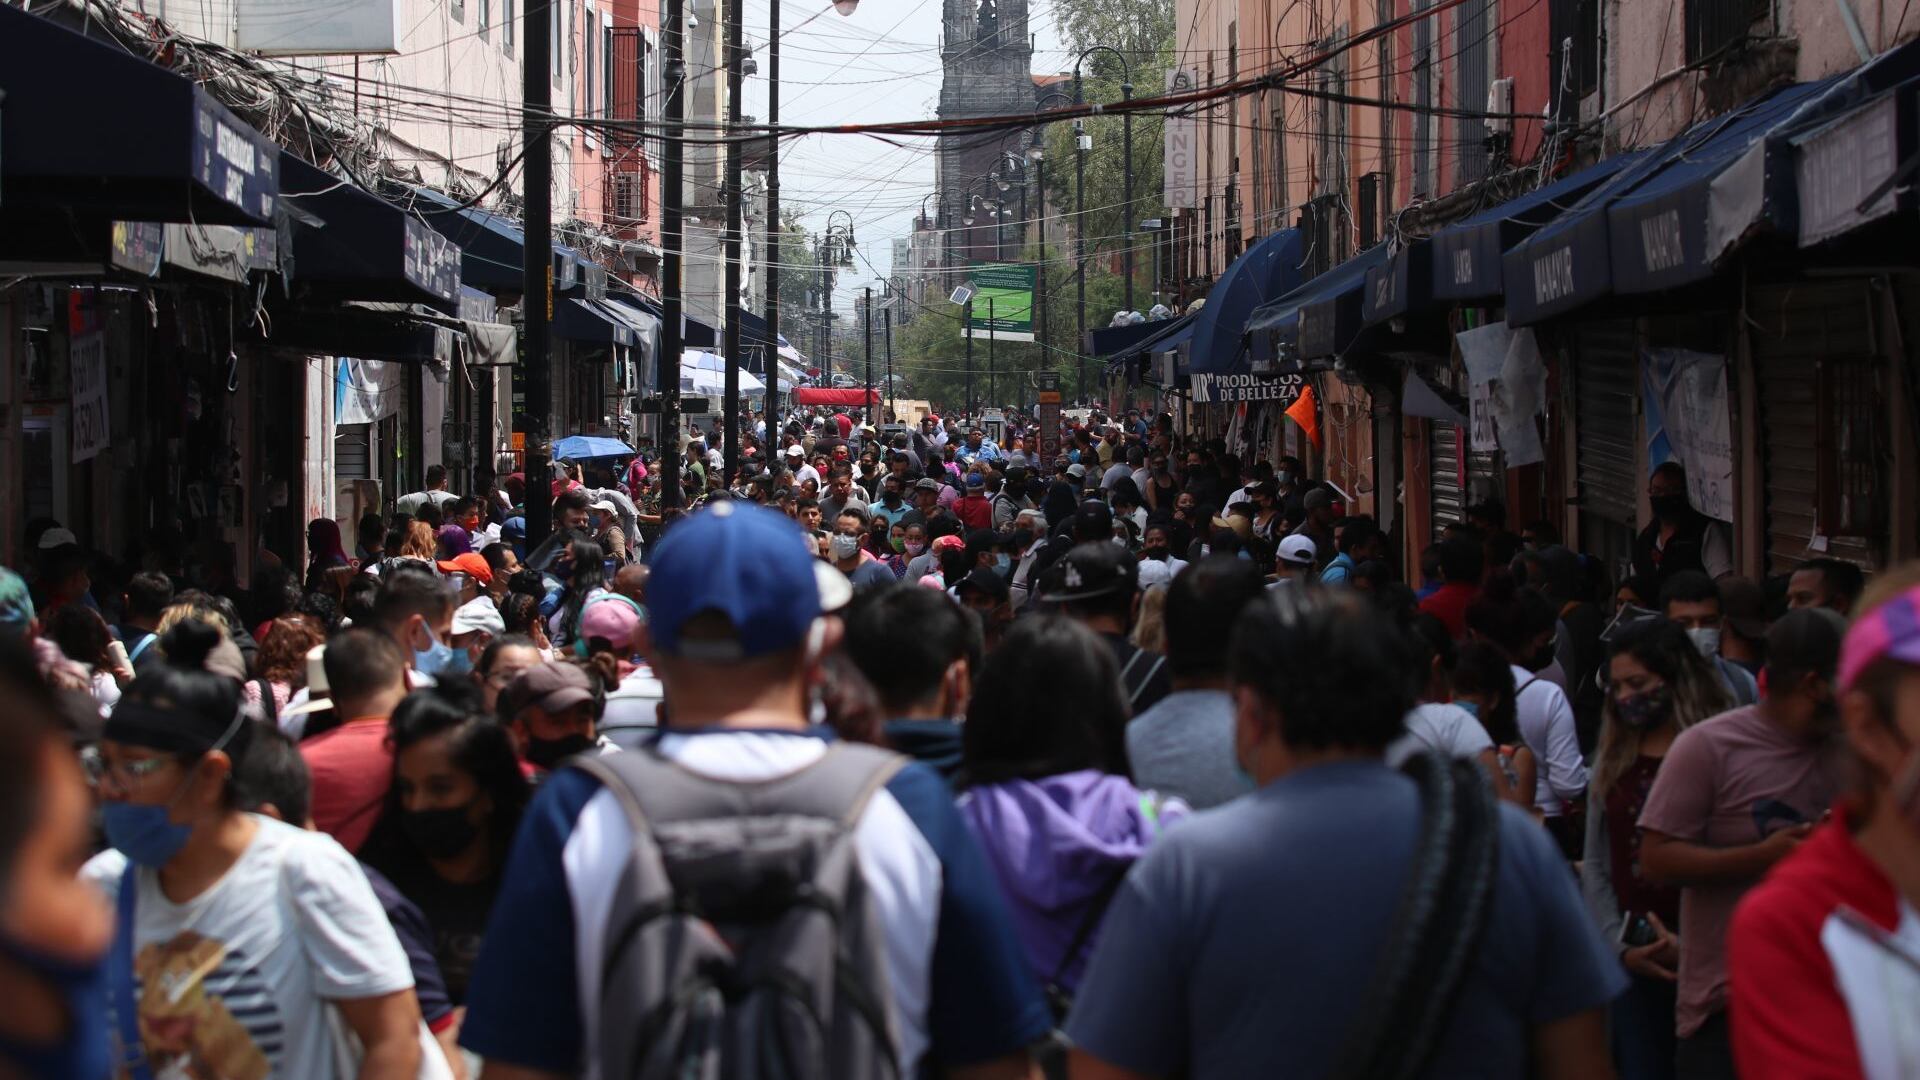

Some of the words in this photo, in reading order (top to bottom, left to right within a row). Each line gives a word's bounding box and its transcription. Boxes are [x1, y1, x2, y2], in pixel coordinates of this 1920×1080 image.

[1171, 77, 1188, 206] SINGER
[1220, 388, 1234, 401] DE
[1239, 385, 1299, 401] BELLEZA
